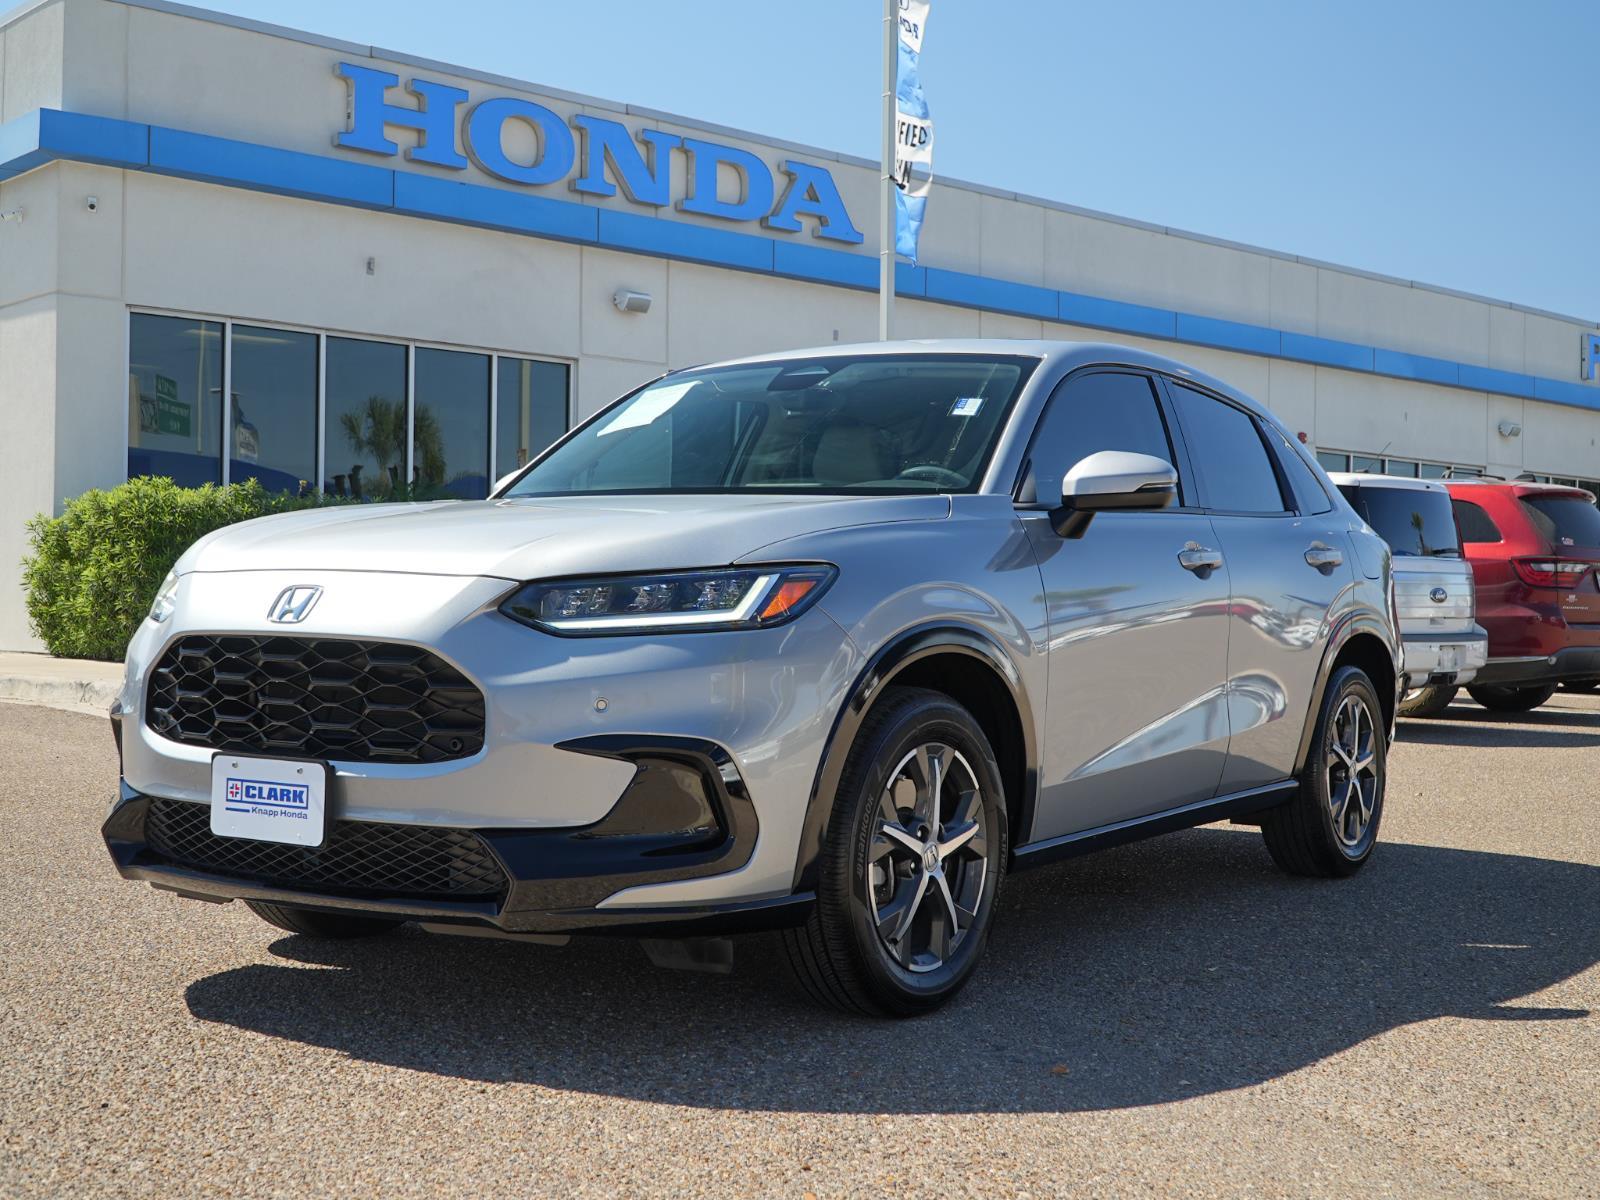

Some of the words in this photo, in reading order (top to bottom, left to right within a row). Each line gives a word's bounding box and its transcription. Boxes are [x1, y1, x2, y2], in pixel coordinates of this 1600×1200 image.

[334, 62, 864, 243] HONDA
[245, 785, 304, 803] CLARK
[252, 807, 278, 816] Knapp
[280, 809, 308, 819] Honda
